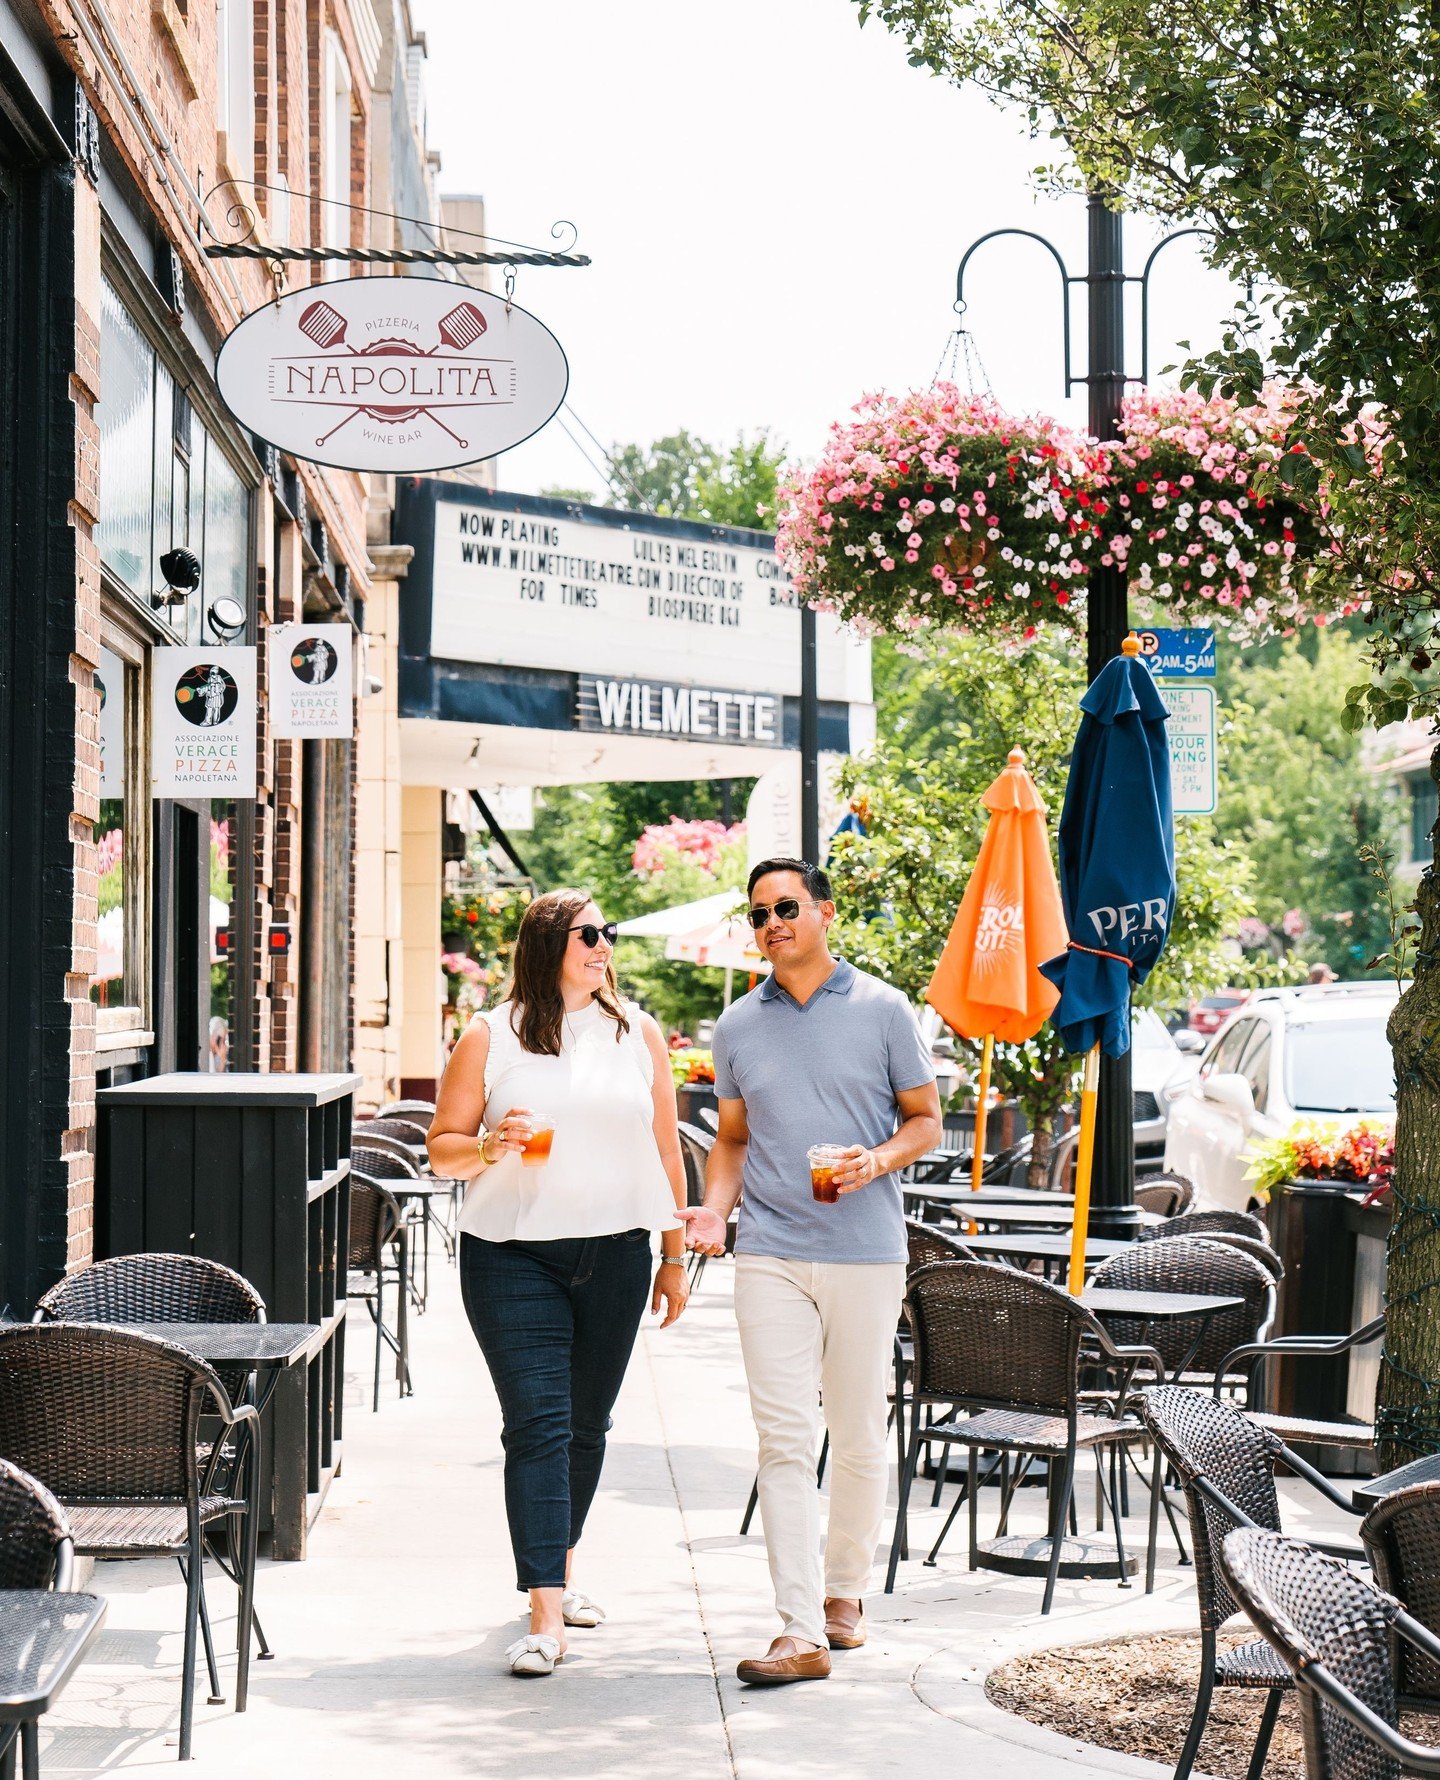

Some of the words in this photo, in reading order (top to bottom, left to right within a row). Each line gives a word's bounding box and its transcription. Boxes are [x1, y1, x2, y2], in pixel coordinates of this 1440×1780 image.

[365, 317, 421, 333] PIZZERIA
[286, 366, 498, 396] NAPOLITA
[362, 428, 394, 445] WINE
[398, 429, 423, 444] BAR
[459, 511, 495, 537] NOW
[501, 519, 559, 546] PLAYING
[520, 578, 545, 601] FOR
[560, 583, 598, 608] TIMES
[291, 698, 338, 708] VERACE
[595, 679, 775, 740] WILMETTE
[291, 708, 338, 719] PIZZA
[174, 744, 239, 757] VERACE
[175, 759, 238, 772] PIZZA
[1176, 763, 1198, 773] ZONE
[174, 774, 238, 782] NAPOLETANA
[1183, 775, 1197, 784] SAT
